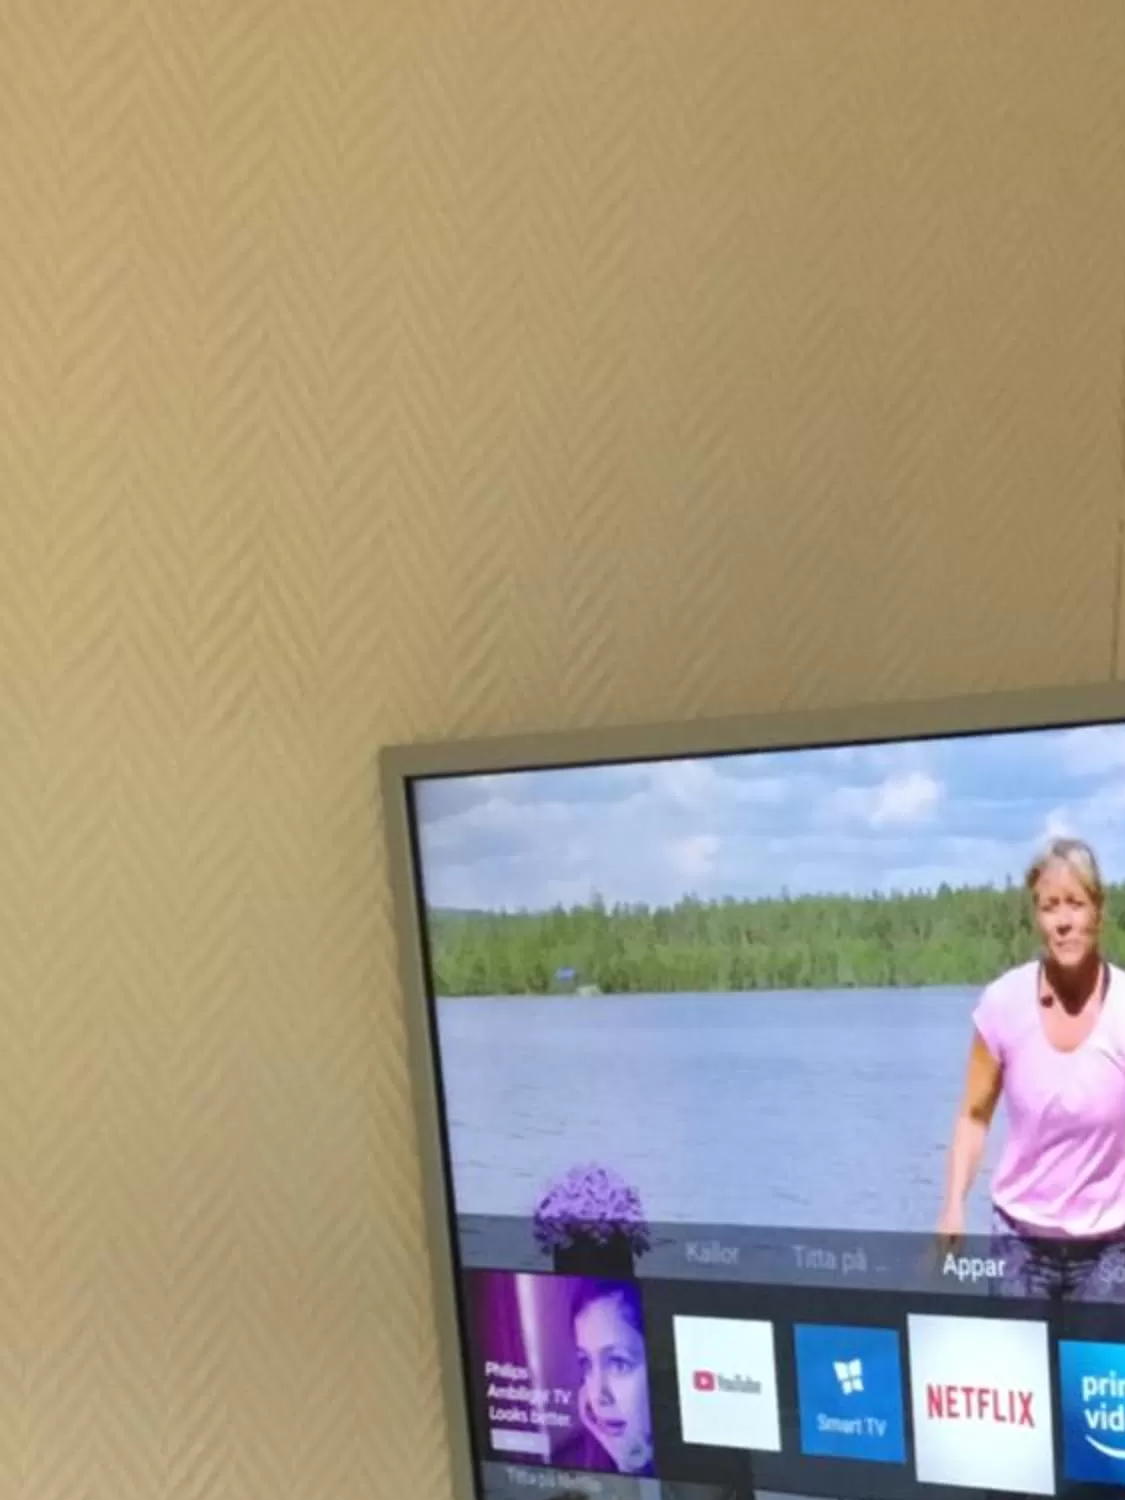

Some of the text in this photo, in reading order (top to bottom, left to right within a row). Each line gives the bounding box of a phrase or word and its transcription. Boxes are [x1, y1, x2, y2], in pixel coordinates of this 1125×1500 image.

[793, 1245, 837, 1272] Titta
[842, 1248, 867, 1276] på
[943, 1253, 1005, 1281] Appar
[552, 1388, 572, 1405] TV
[926, 1383, 1036, 1429] NETFLIX
[816, 1412, 888, 1437] Smart TV
